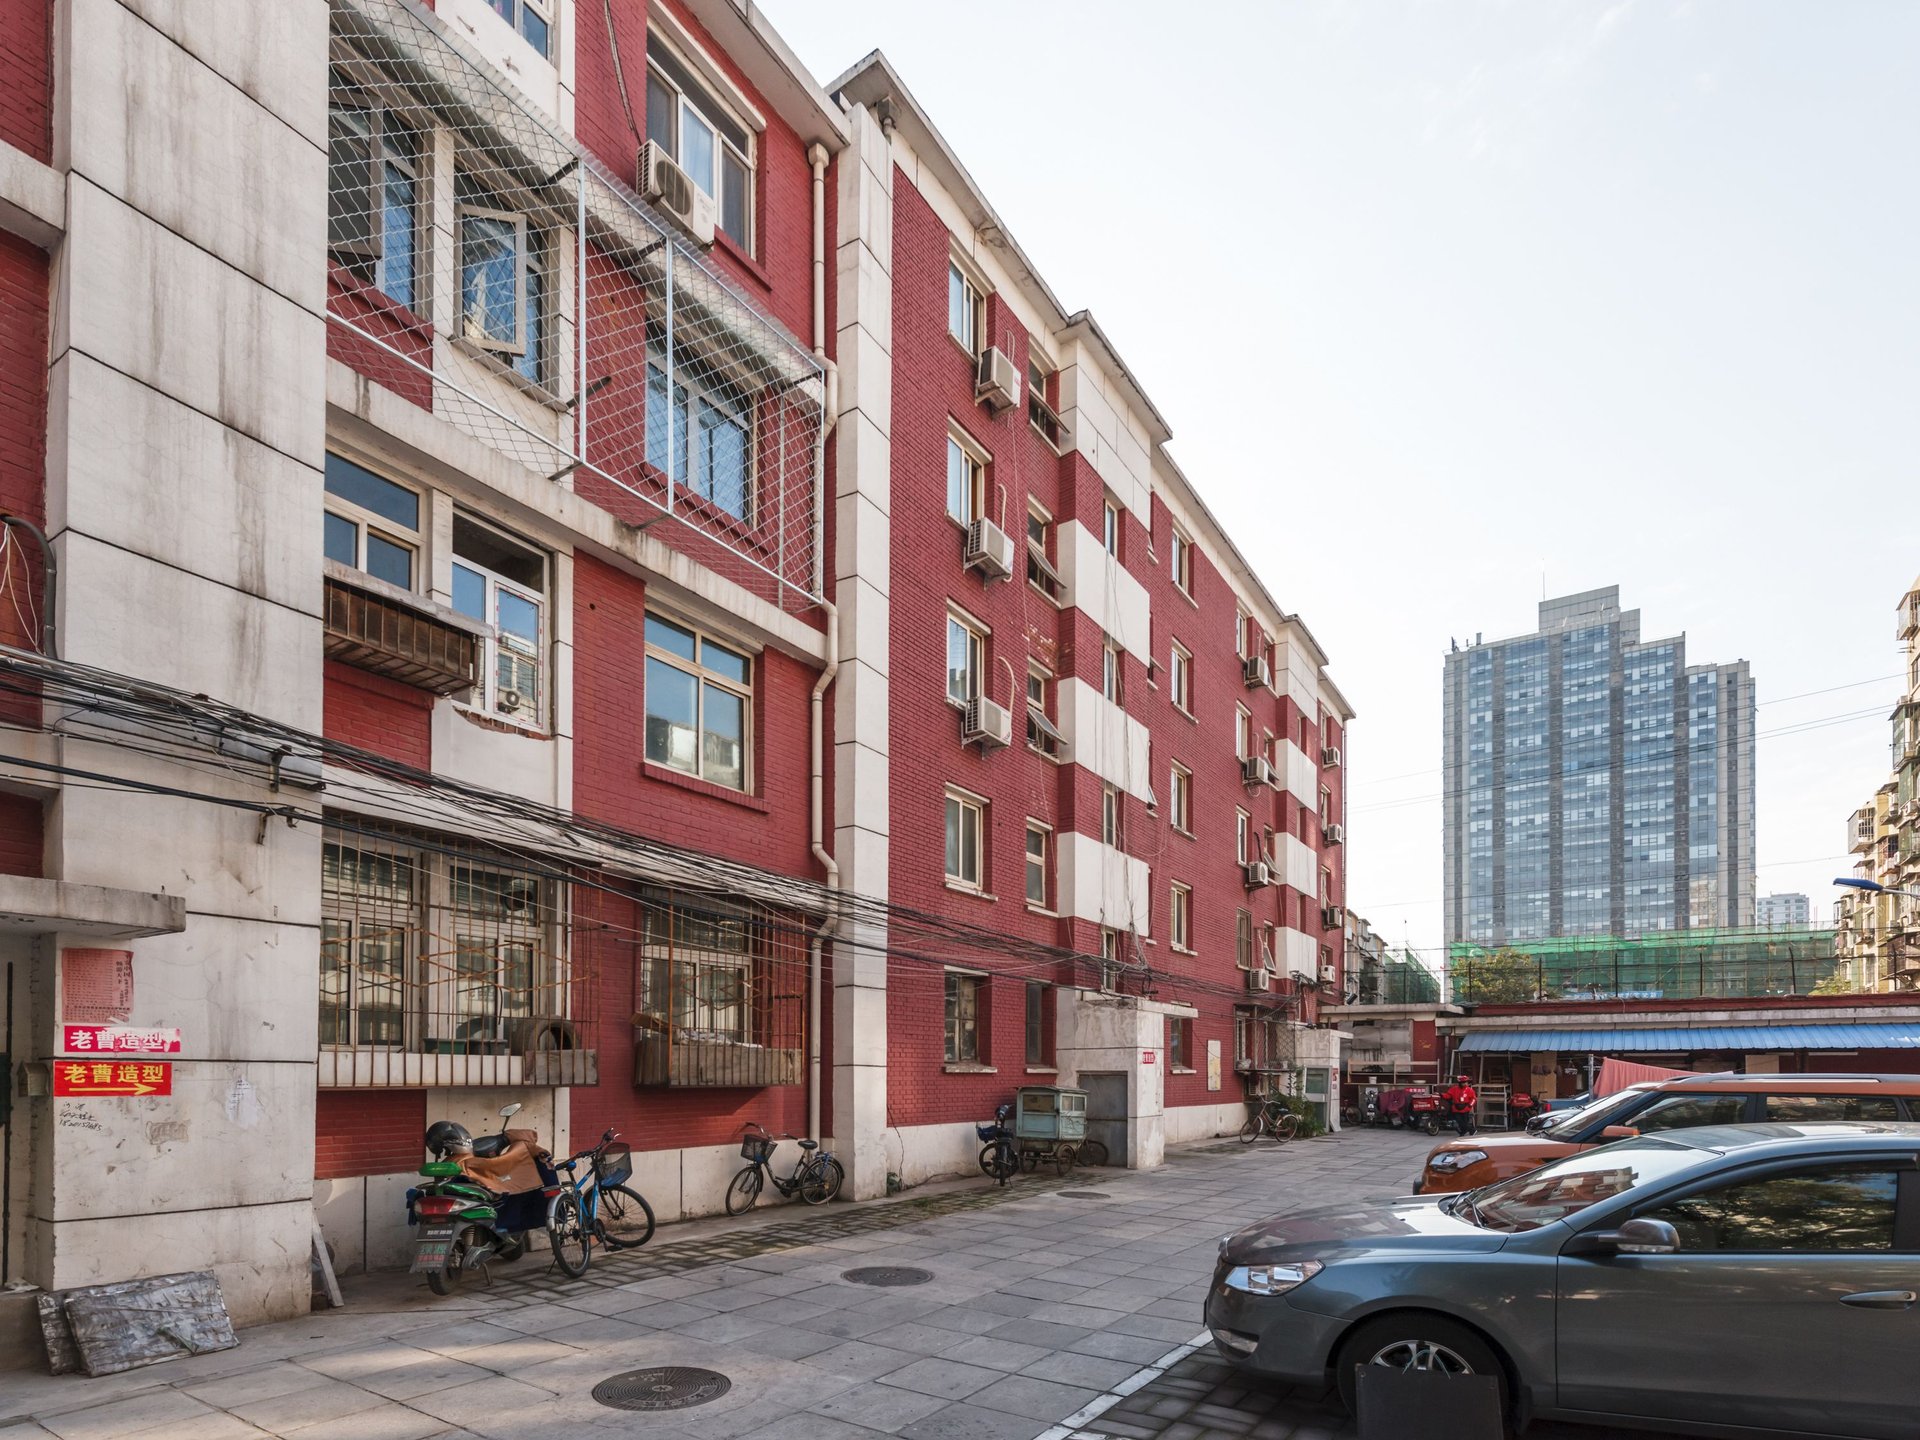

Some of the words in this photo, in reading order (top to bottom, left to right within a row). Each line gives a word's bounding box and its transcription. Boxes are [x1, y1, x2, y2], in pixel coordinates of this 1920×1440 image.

[70, 1030, 163, 1050] 老曹造型
[64, 1064, 164, 1083] 老曹造型
